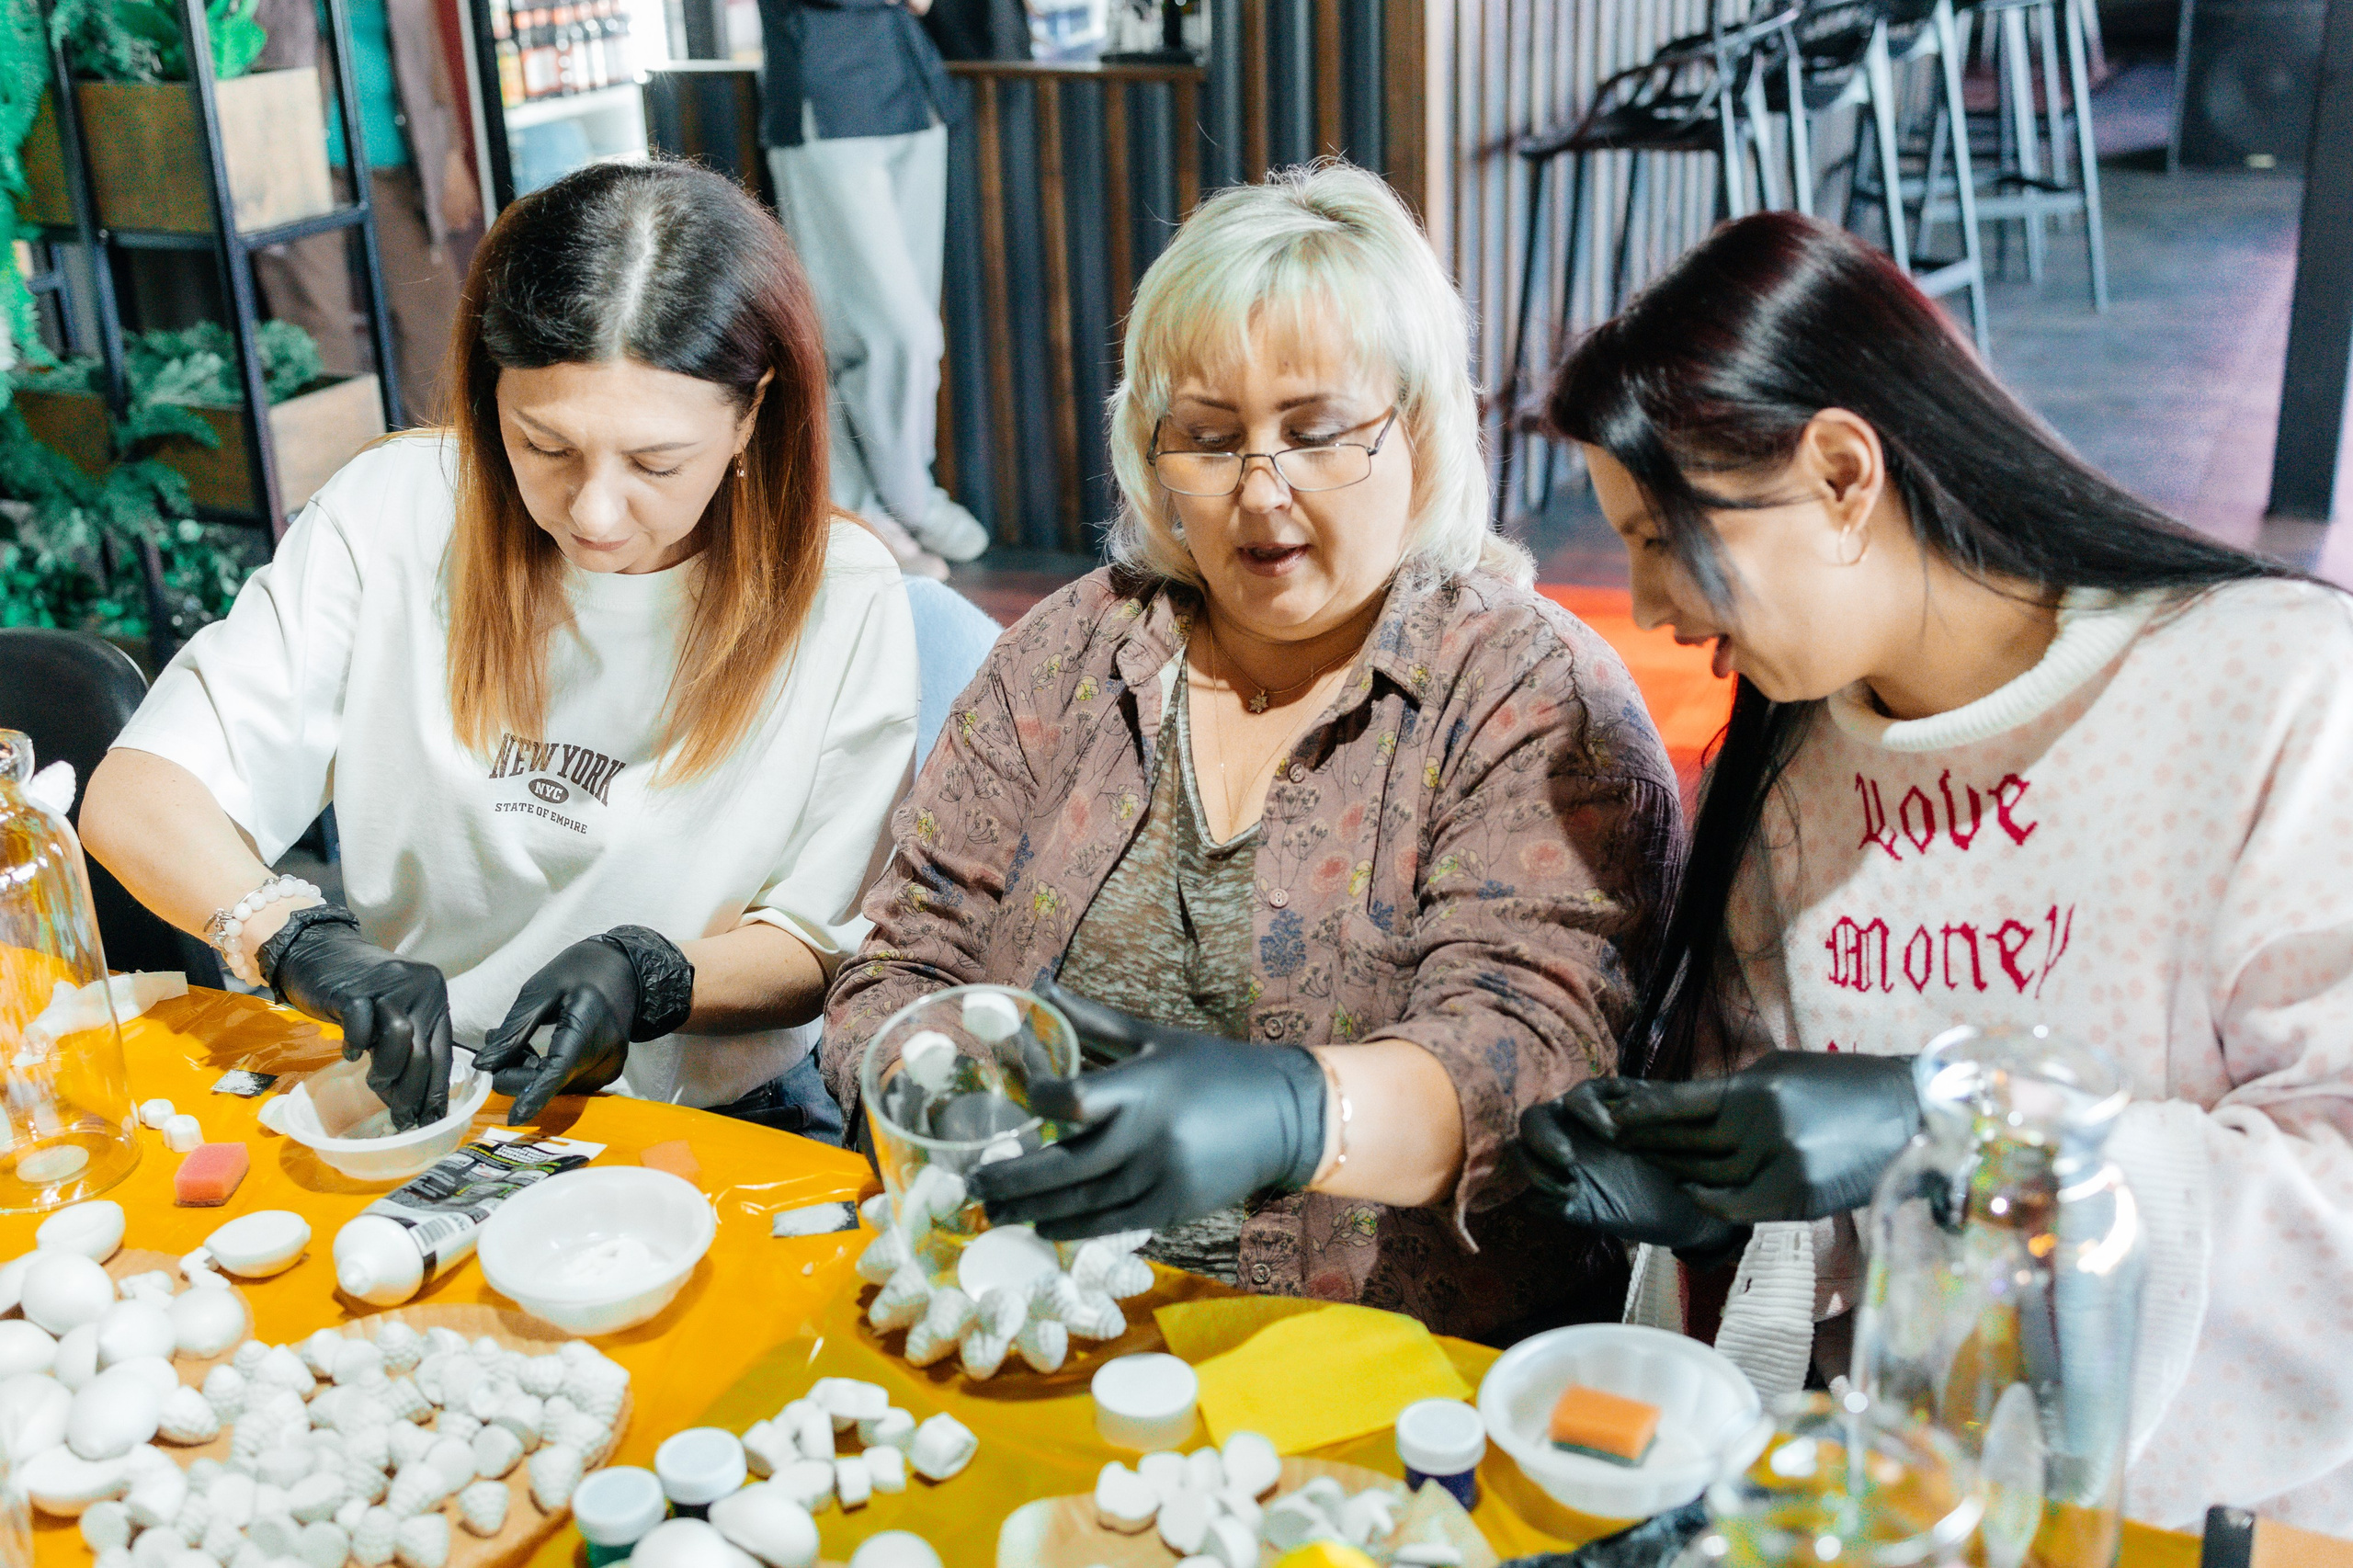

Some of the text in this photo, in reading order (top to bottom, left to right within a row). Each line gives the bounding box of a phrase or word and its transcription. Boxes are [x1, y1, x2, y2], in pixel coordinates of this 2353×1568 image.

[489, 733, 627, 807] NEW YORK
[534, 781, 564, 801] NYC
[494, 802, 588, 835] STATE OF EMPIRE
[1855, 769, 2039, 861] Love
[1825, 903, 2075, 999] Money
